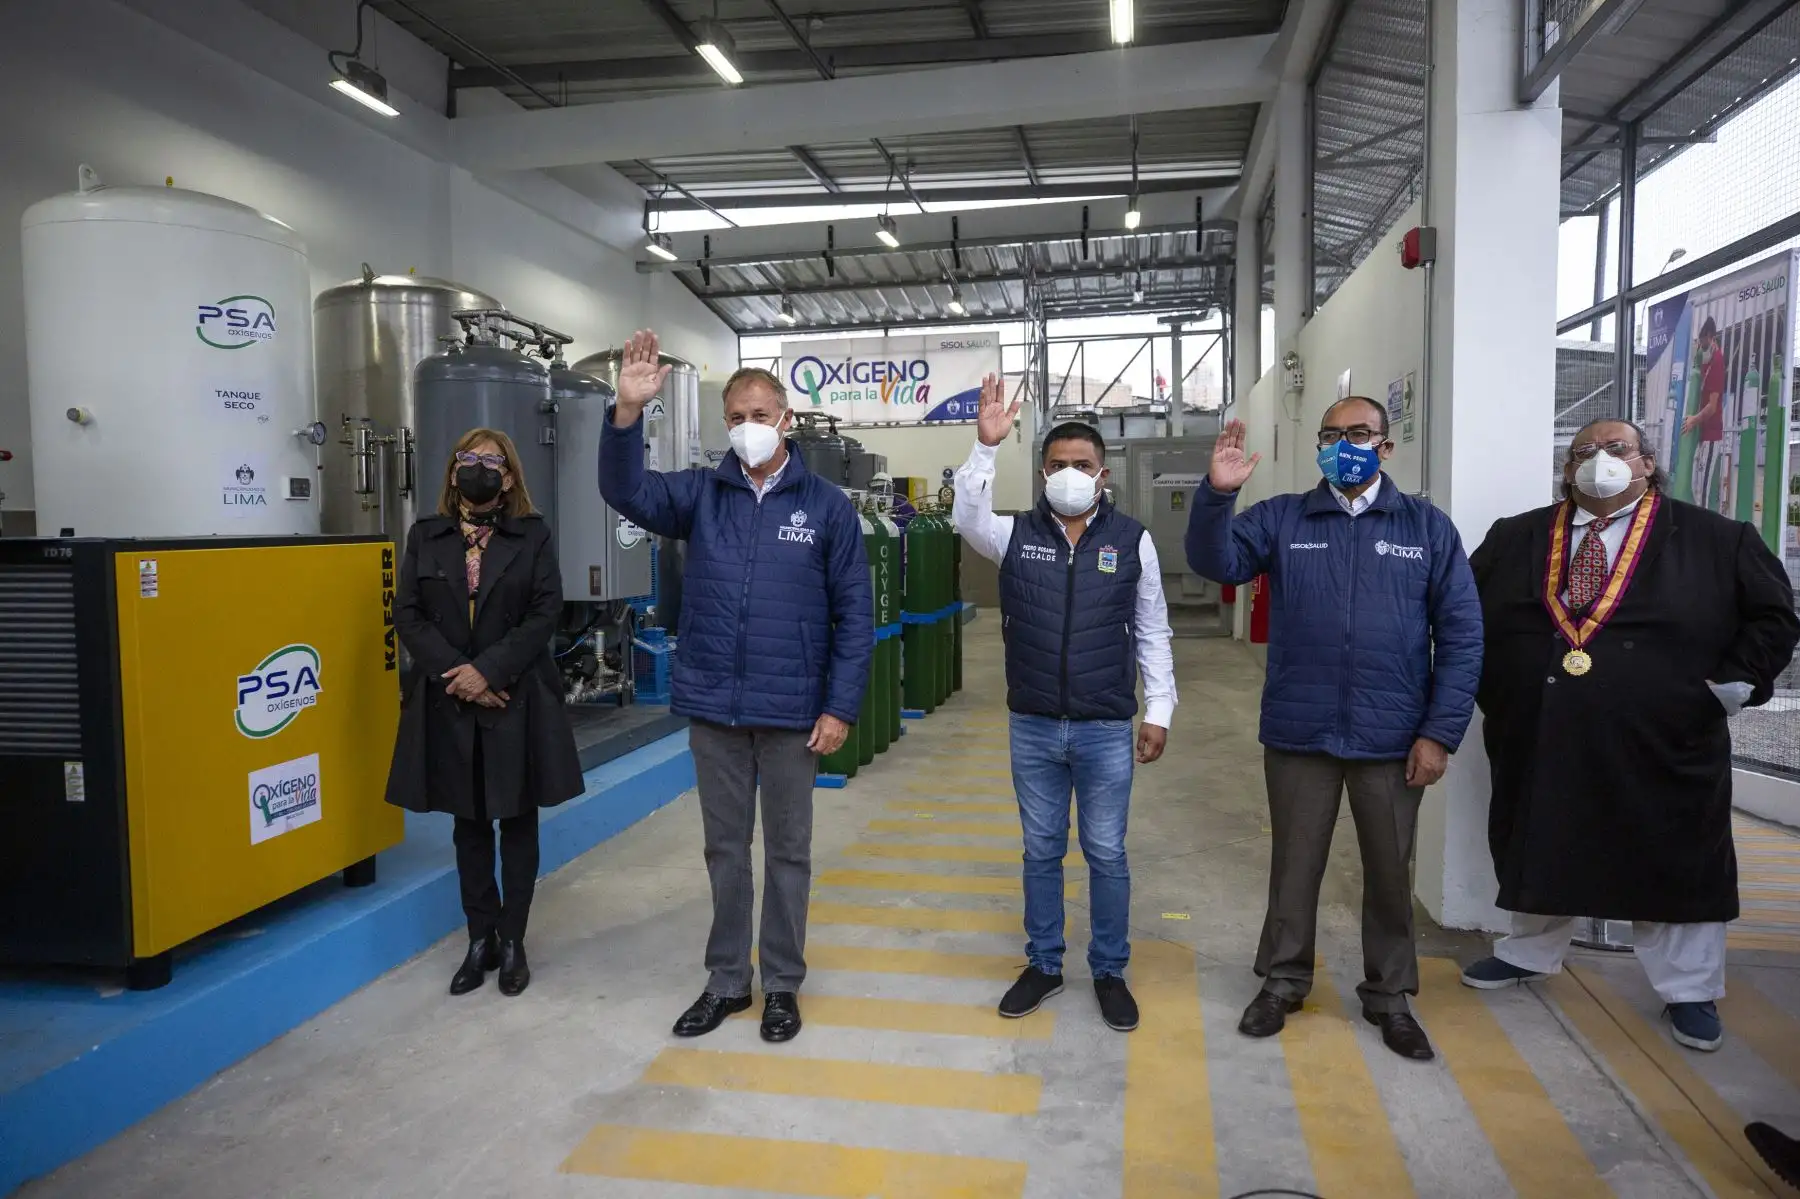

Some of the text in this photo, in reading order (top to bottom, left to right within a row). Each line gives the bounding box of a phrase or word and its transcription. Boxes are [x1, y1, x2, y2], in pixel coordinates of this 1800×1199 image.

[1738, 276, 1786, 302] SISOL SALUD
[198, 305, 276, 332] PSA
[940, 339, 992, 349] SISOL SALUD
[1649, 332, 1668, 349] LIMA
[215, 389, 262, 401] TANQUE
[830, 373, 931, 406] para la Vida
[224, 401, 255, 410] SECO
[965, 404, 981, 414] LI
[223, 493, 267, 506] LIMA
[778, 530, 814, 545] LIMA
[1021, 551, 1057, 562] ALCALDE
[1038, 546, 1056, 554] ROSARIO
[1392, 547, 1423, 560] LIMA
[880, 545, 889, 624] OXYGE
[381, 548, 397, 671] KAESER
[238, 666, 320, 705] PSA
[272, 799, 288, 812] para
[288, 796, 295, 805] la
